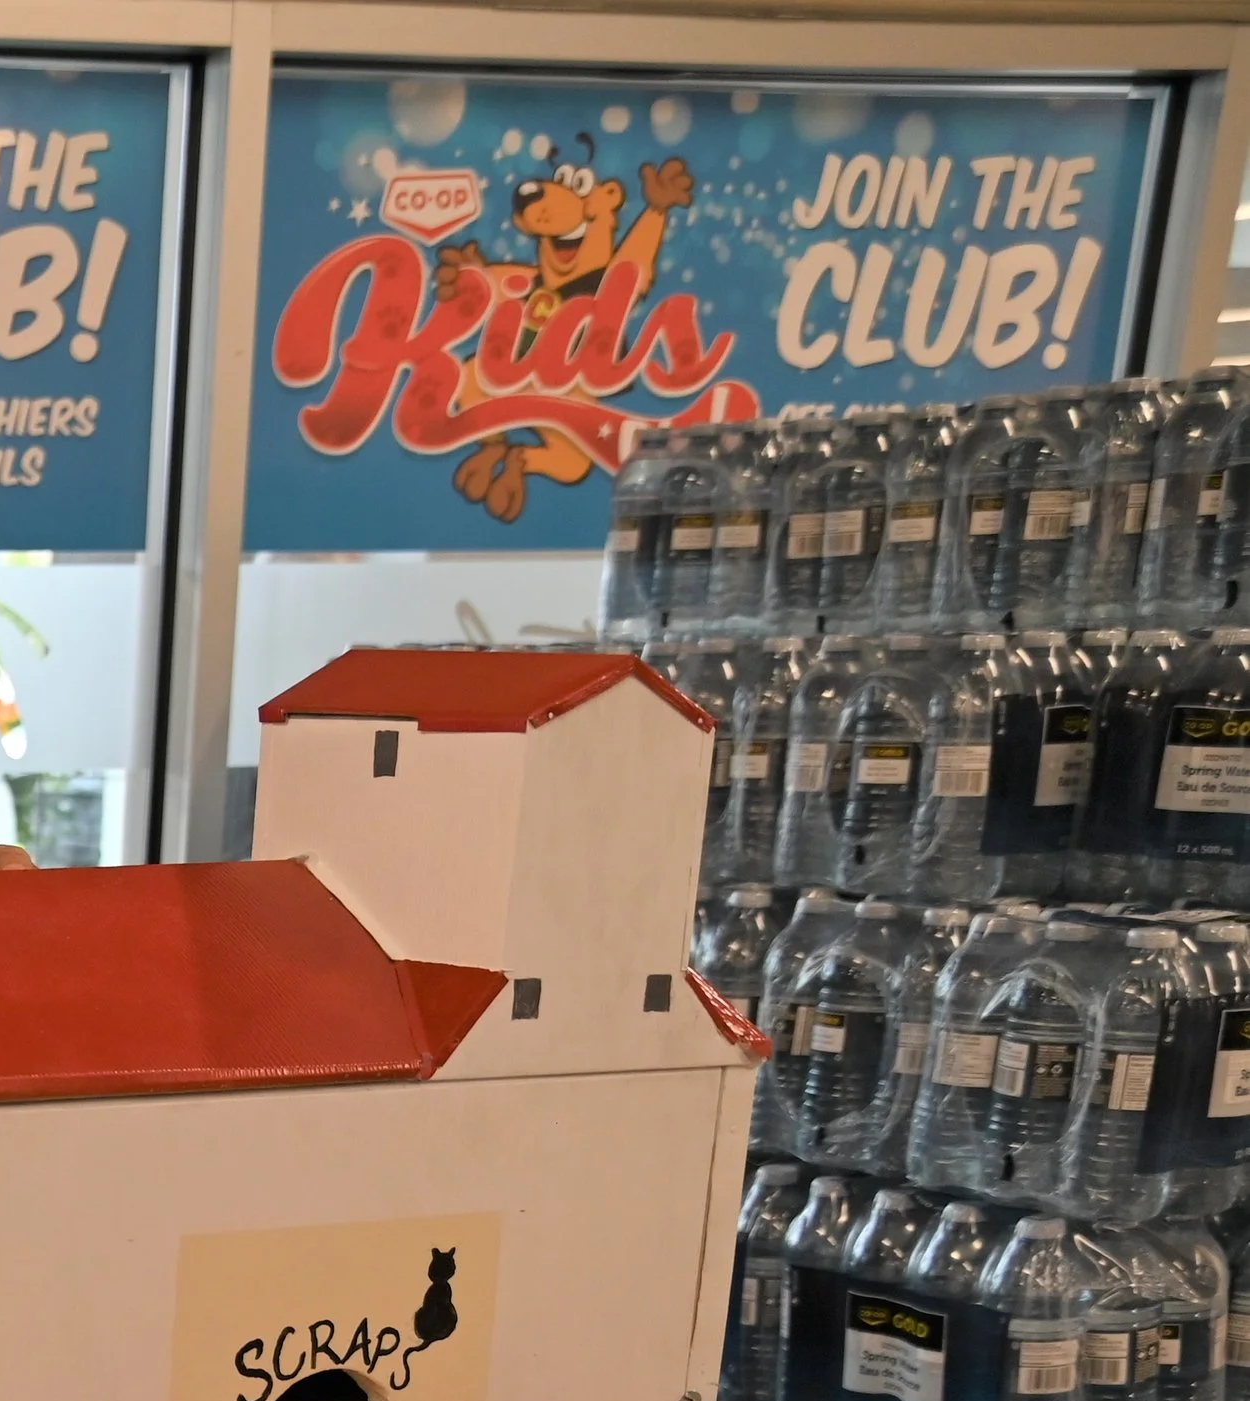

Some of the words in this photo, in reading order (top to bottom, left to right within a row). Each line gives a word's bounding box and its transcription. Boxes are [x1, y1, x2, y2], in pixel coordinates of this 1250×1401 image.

[792, 152, 953, 229] JOIN
[969, 154, 1096, 231] THE
[272, 234, 736, 456] Kids
[777, 236, 1102, 370] CLUB!
[892, 1313, 929, 1338] GOLD
